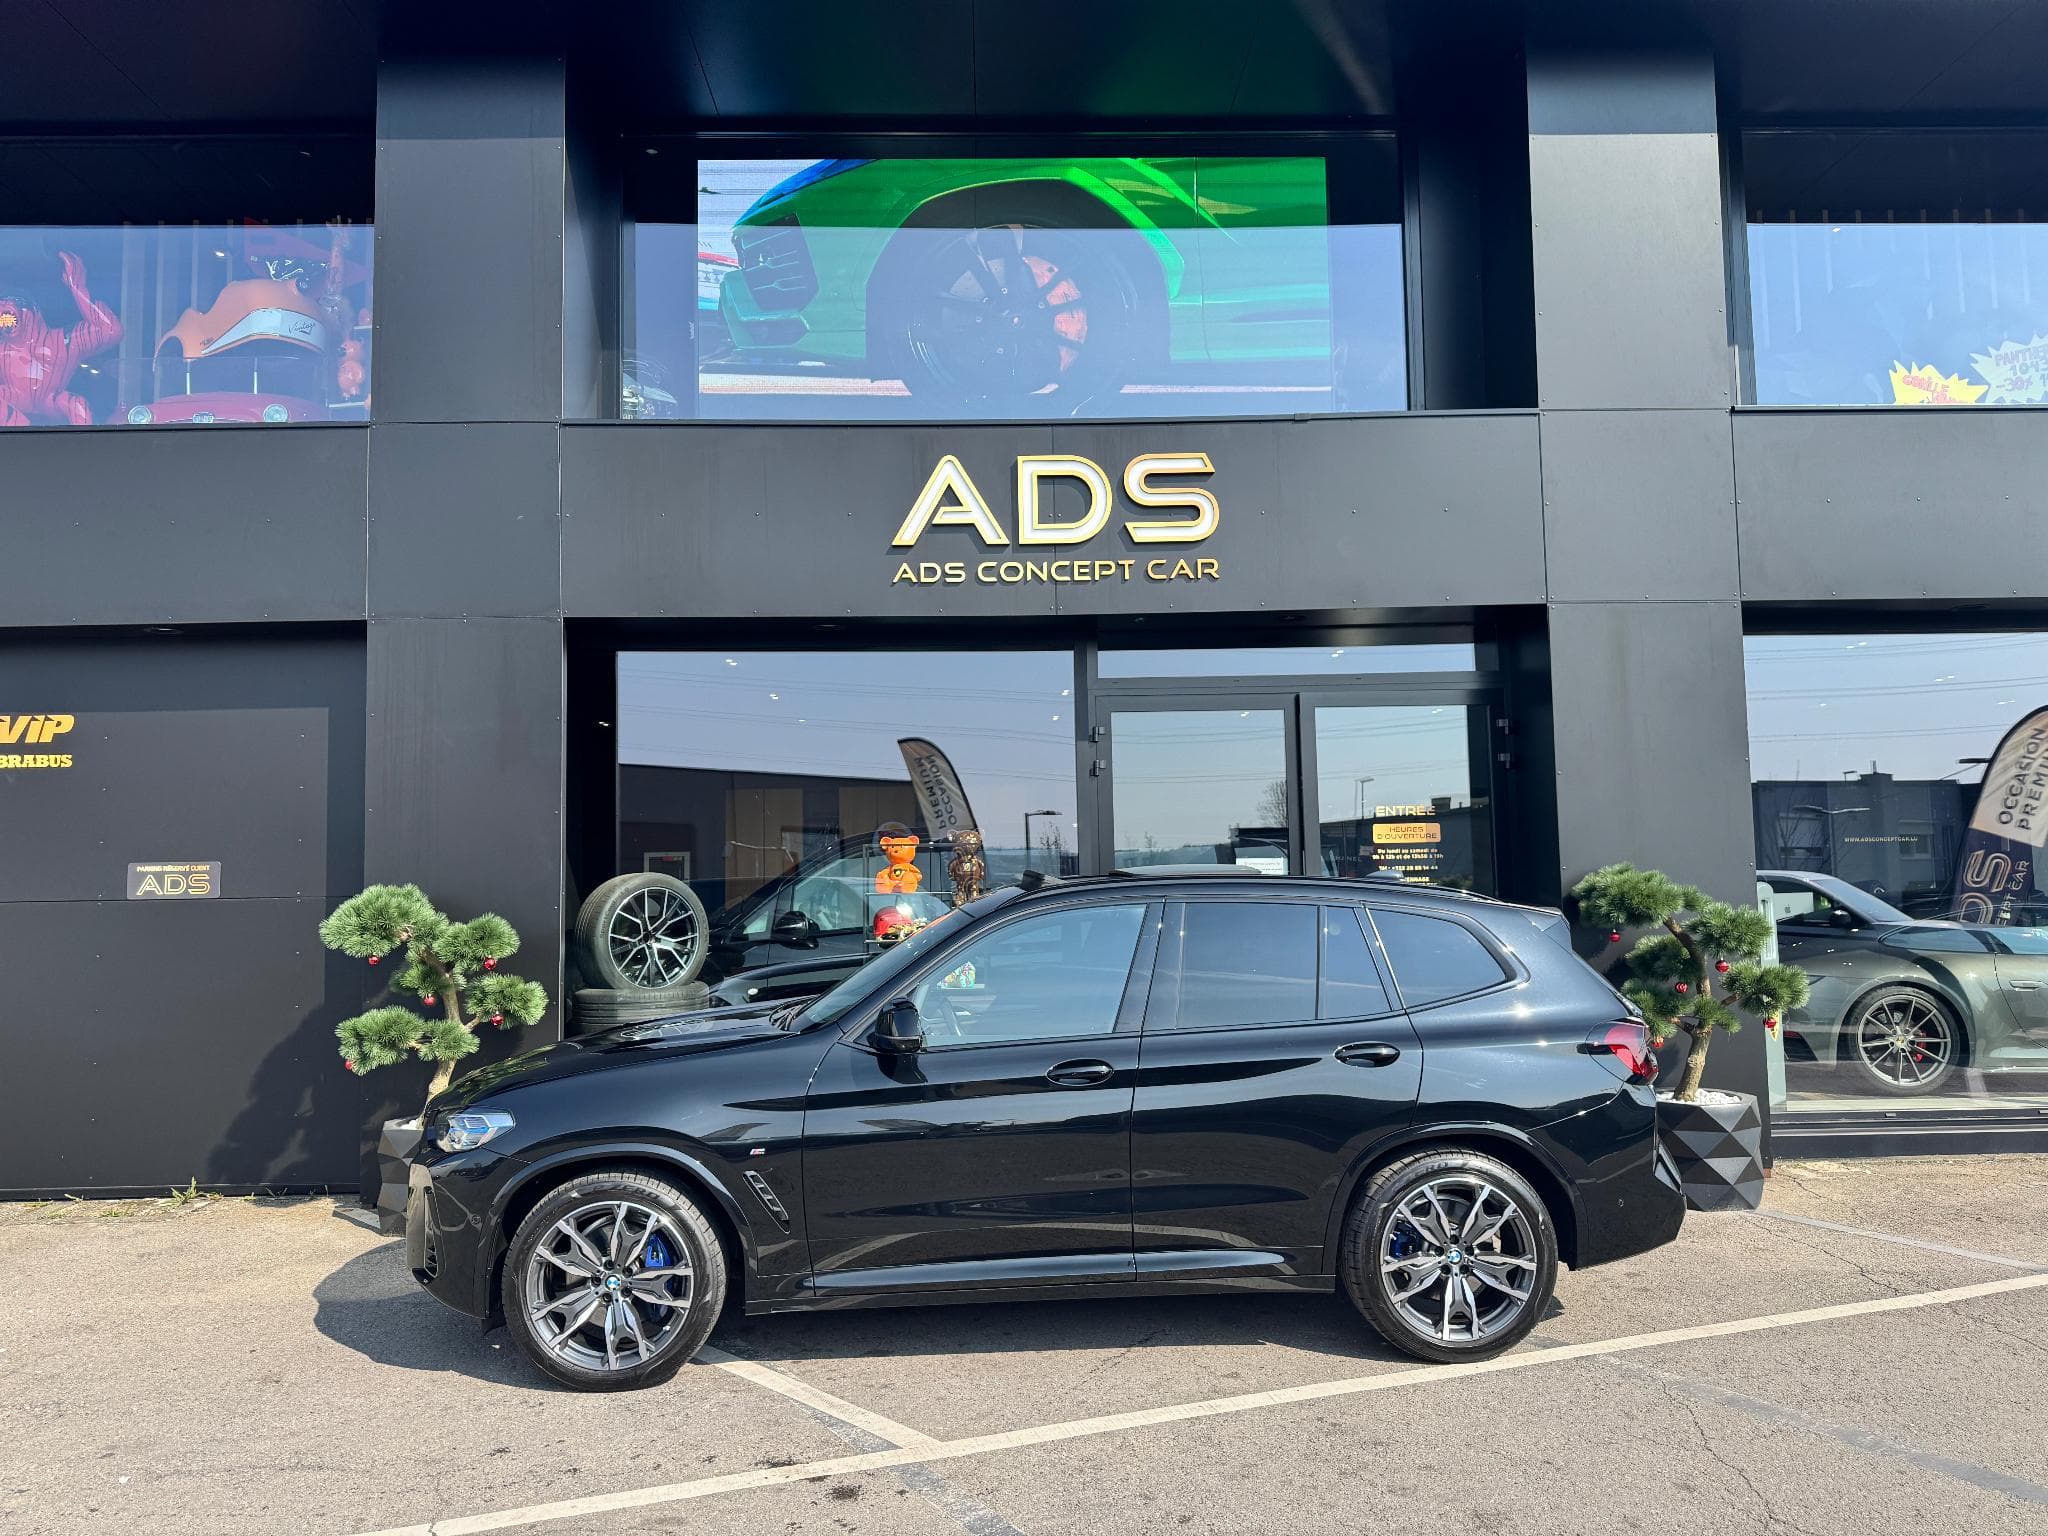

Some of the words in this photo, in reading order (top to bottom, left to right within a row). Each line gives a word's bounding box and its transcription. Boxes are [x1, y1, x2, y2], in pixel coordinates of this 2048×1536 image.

[891, 452, 1220, 546] ADS
[892, 562, 966, 584] ADS
[977, 560, 1136, 583] CONCEPT
[1147, 558, 1220, 580] CAR
[0, 754, 73, 768] BRABUS
[1998, 727, 2046, 825] OCCASION
[136, 873, 210, 896] ADS
[1957, 849, 2012, 925] DS
